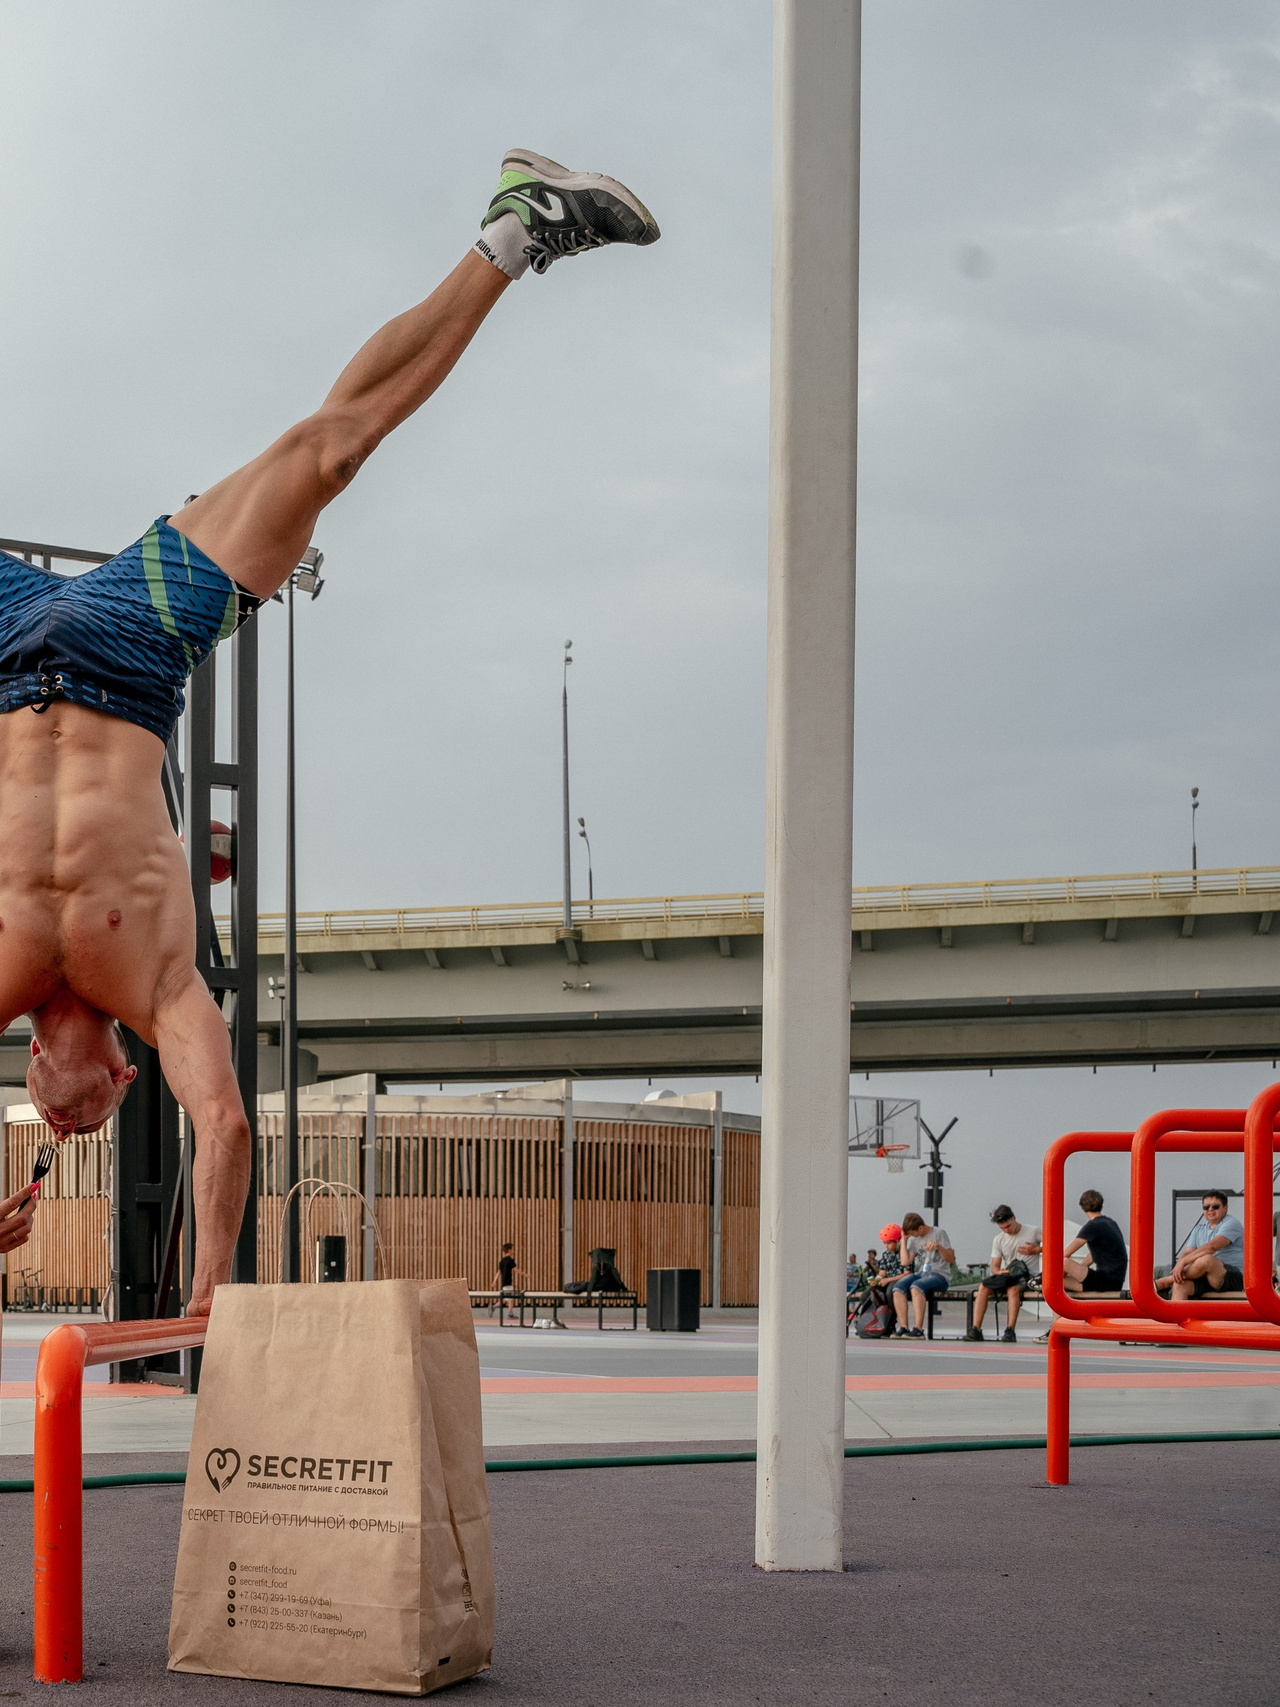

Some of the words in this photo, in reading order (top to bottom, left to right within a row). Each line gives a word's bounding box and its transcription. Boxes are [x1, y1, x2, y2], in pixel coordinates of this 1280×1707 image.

[247, 1454, 393, 1483] SECRETFIT
[247, 1481, 297, 1491] ПРАВИЛЬНОЕ
[298, 1484, 333, 1493] ПИТАНИЕ
[340, 1486, 389, 1496] ДОСТАВКОЙ
[188, 1508, 226, 1522] СЕКРЕТ
[228, 1509, 269, 1525] ТВОЕЙ
[272, 1513, 346, 1530] ОТЛИЧНОЙ
[349, 1518, 404, 1534] ФОРМЫ!
[239, 1564, 297, 1576] secretfit-food.ru
[239, 1578, 288, 1589] secretfit_food
[239, 1591, 249, 1599] +7
[250, 1591, 269, 1602] (347)
[270, 1593, 309, 1605] 299-19-69
[309, 1596, 332, 1608] (Уфа)
[250, 1605, 269, 1616] (843)
[270, 1606, 309, 1618] 25-00-337
[310, 1609, 343, 1623] (Казань)
[239, 1618, 249, 1627] +7
[250, 1619, 269, 1631] (922)
[270, 1621, 309, 1633] 225-55-20
[310, 1624, 367, 1640] (Екатеринбург)
